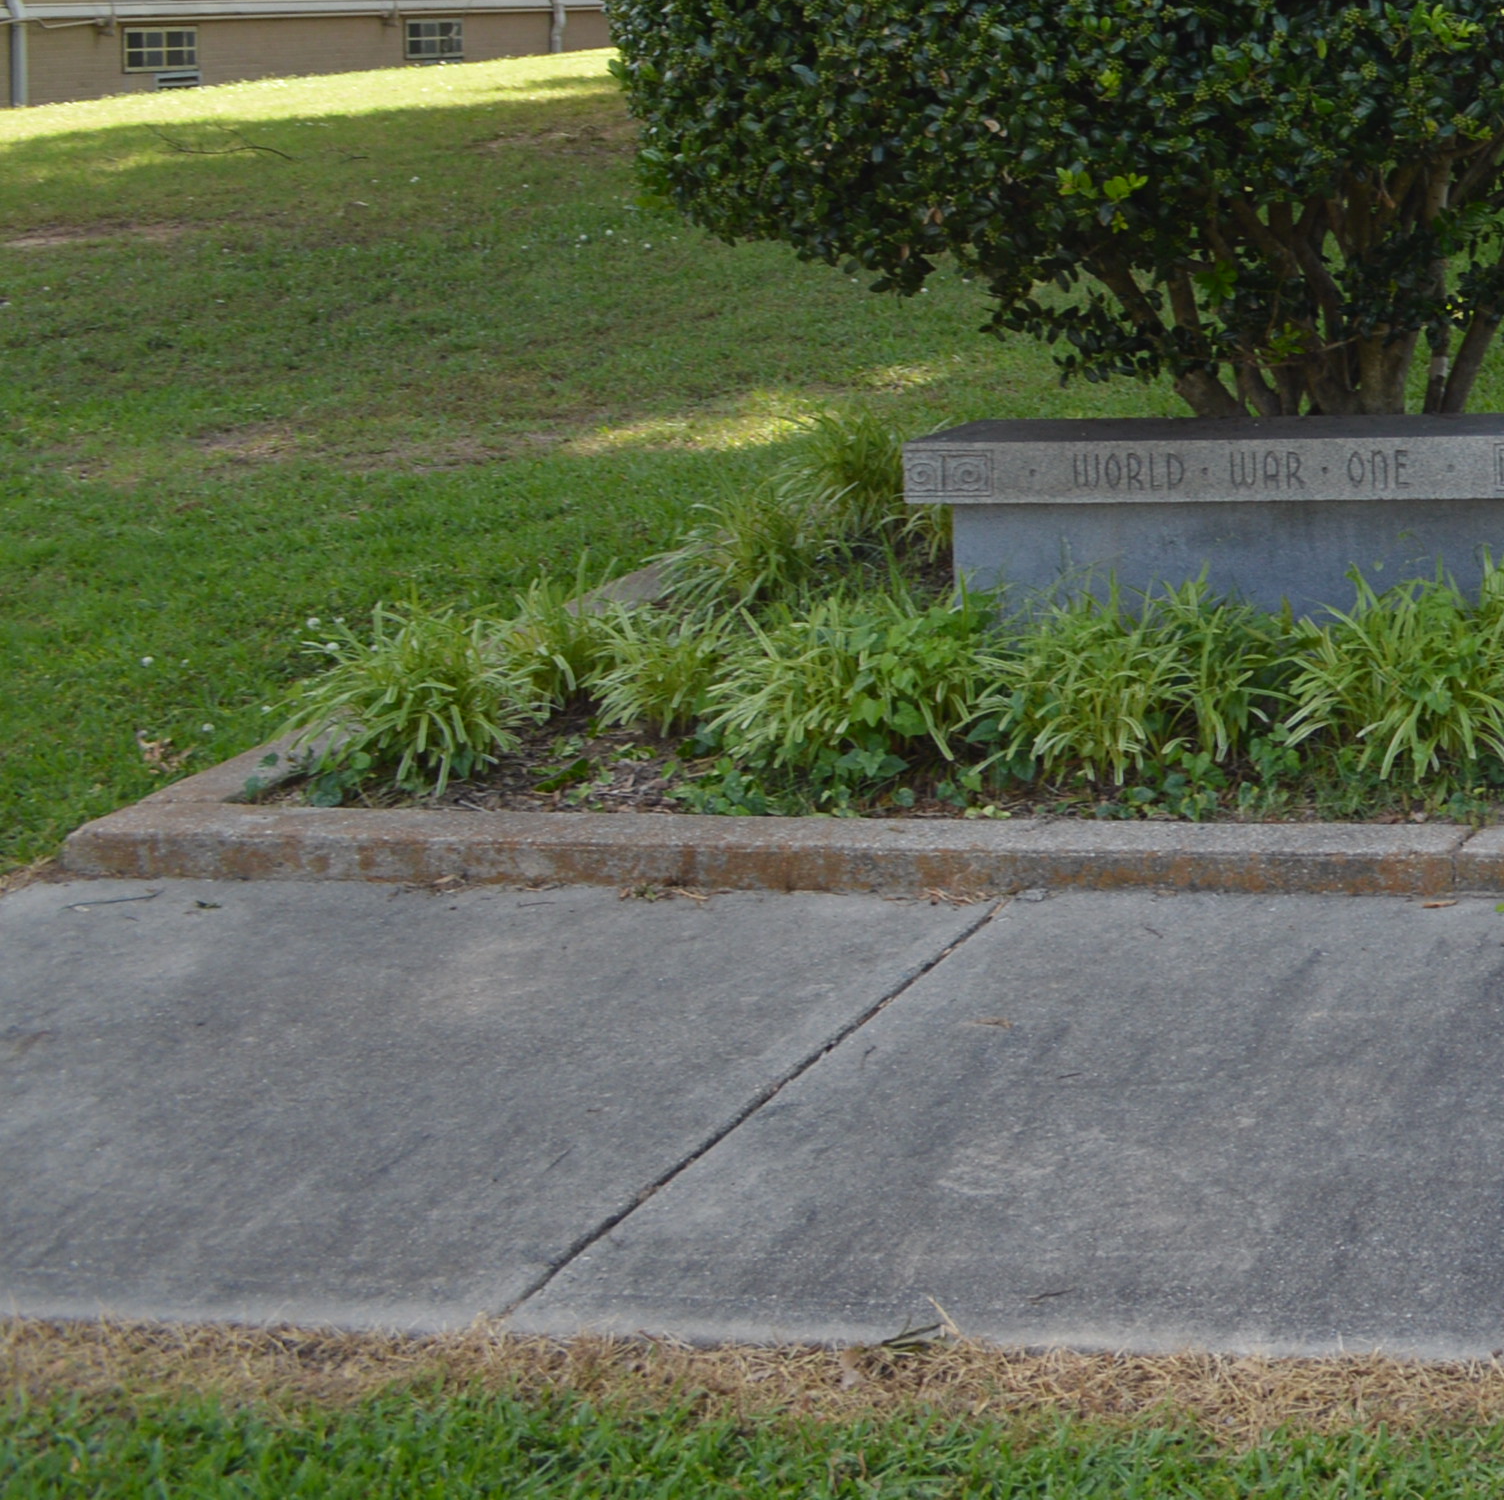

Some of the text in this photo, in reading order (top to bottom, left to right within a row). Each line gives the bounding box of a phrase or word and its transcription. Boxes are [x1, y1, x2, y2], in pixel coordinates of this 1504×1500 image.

[1073, 450, 1411, 490] WORLD WAR ONE
